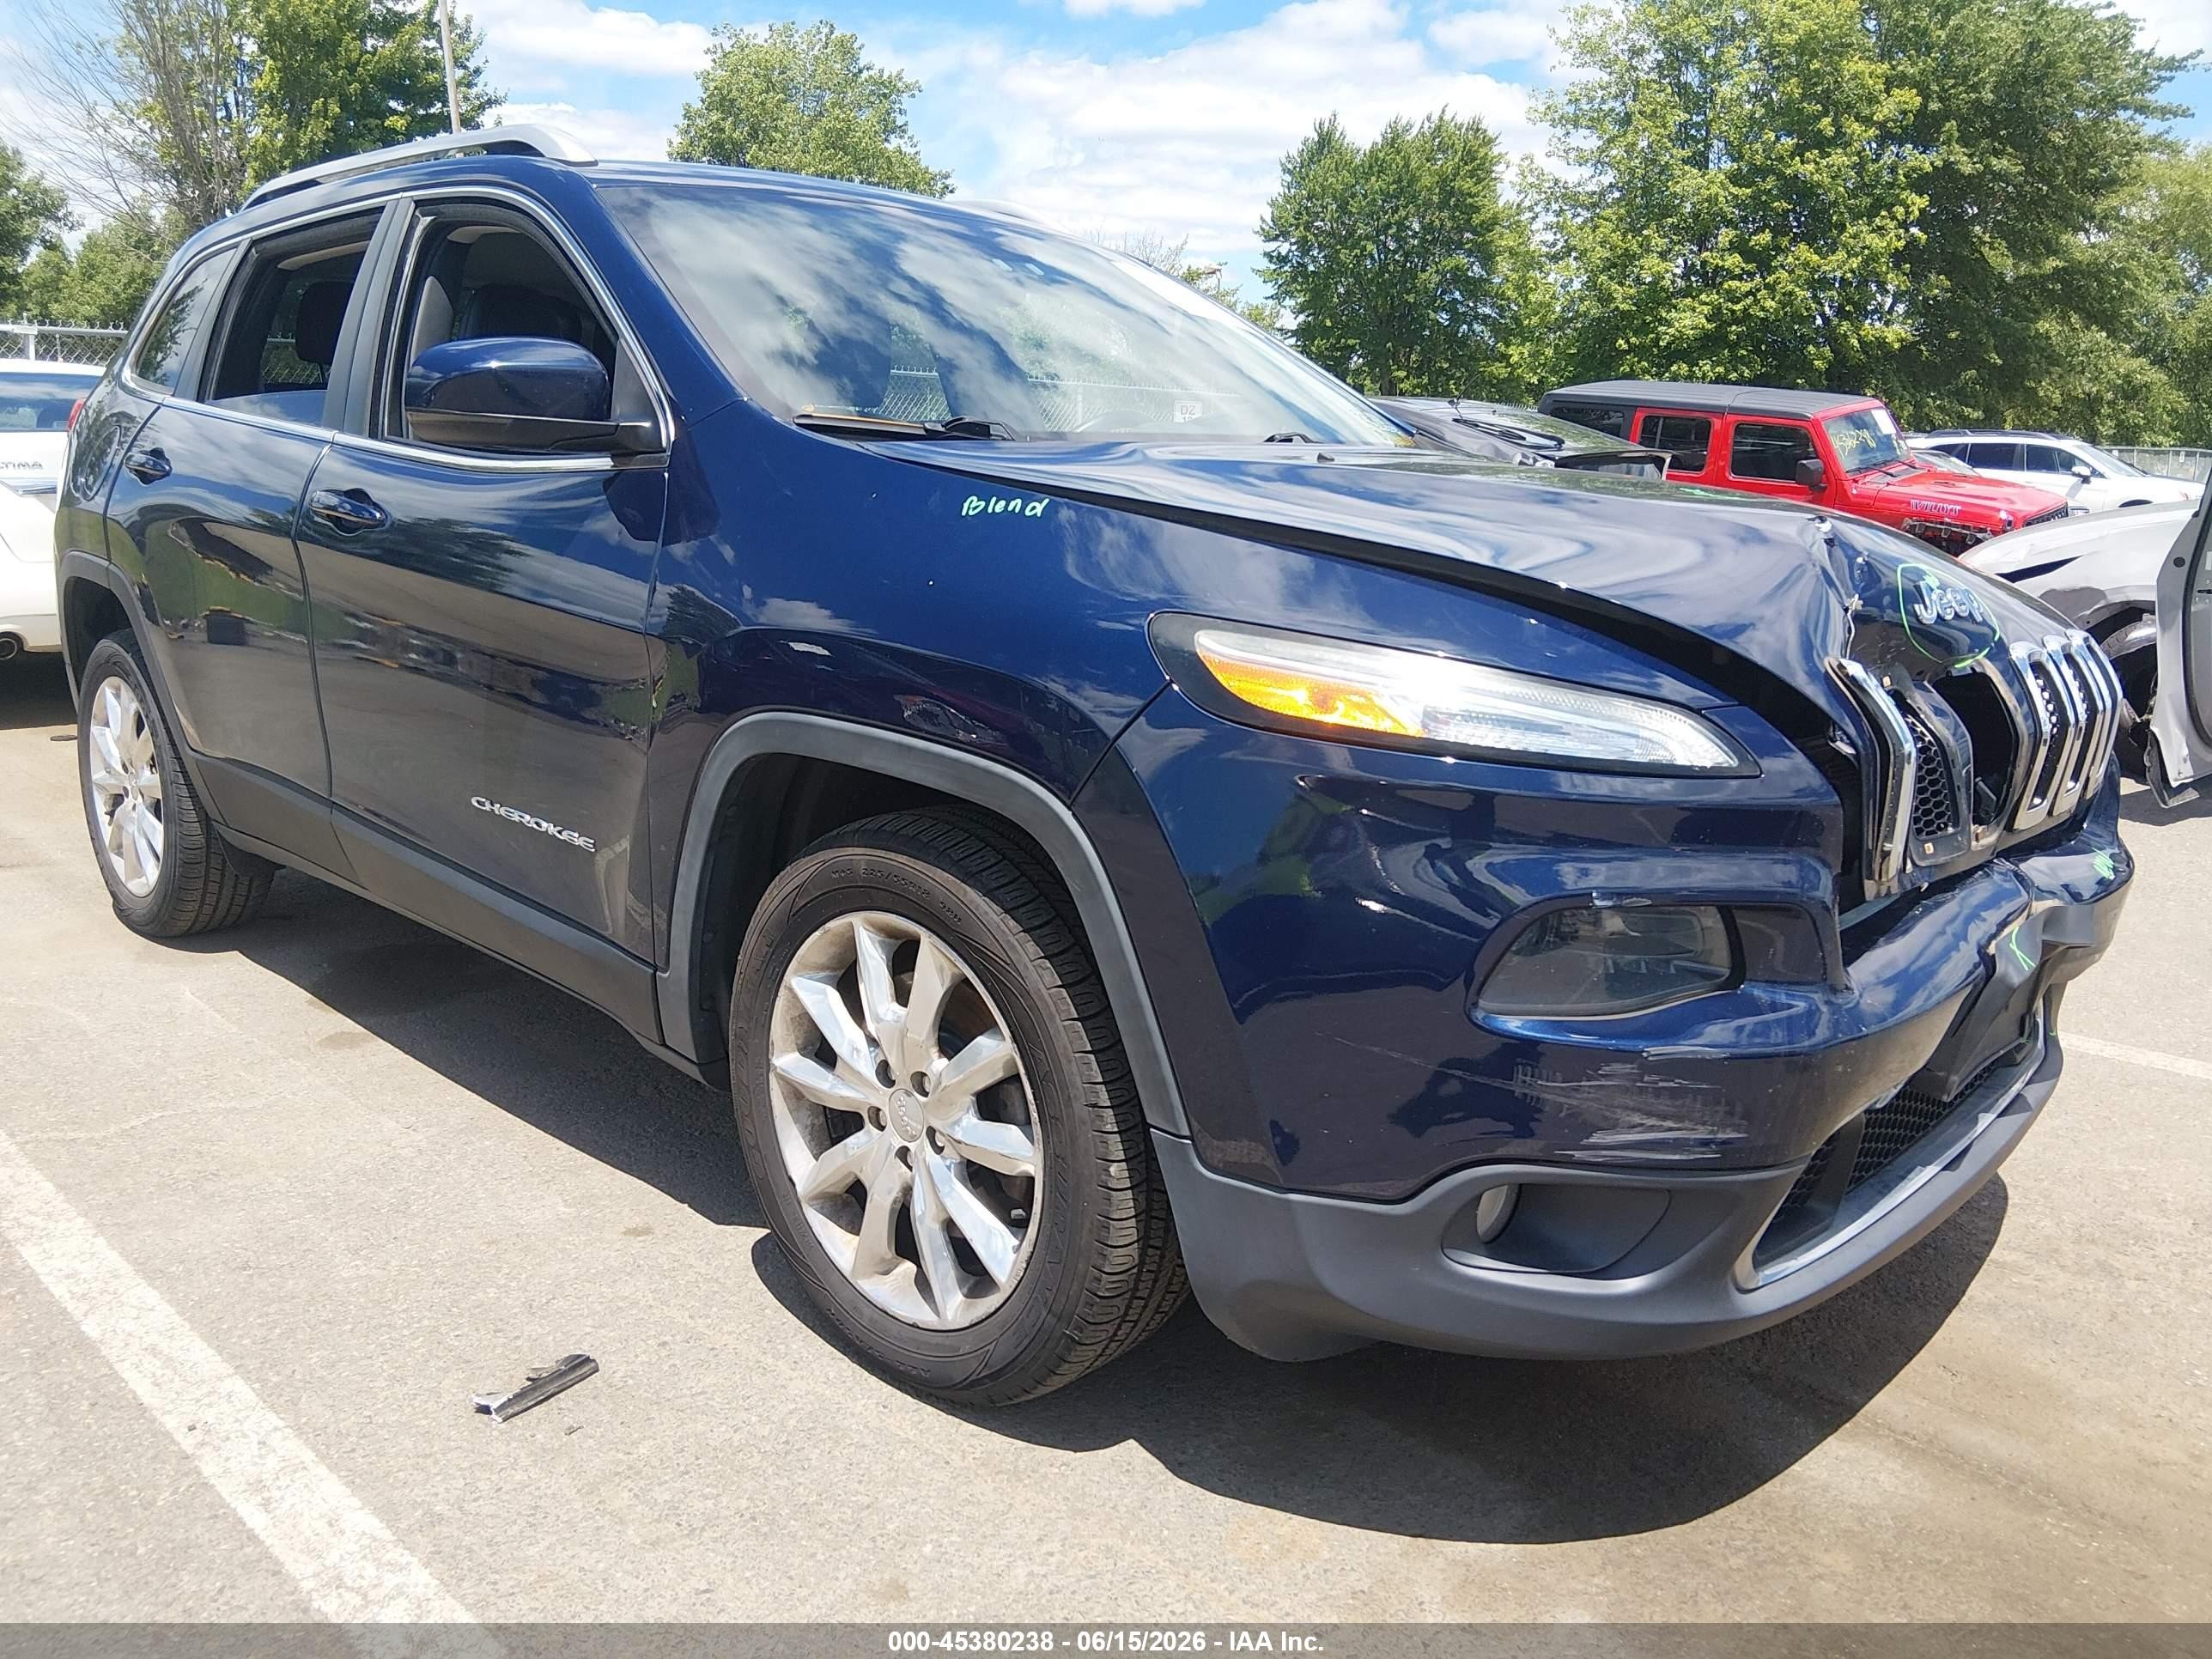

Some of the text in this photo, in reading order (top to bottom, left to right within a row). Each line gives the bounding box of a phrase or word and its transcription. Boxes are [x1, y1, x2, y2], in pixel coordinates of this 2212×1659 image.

[961, 495, 1050, 517] Blend
[1910, 500, 1962, 517] WILLYS
[1912, 580, 1984, 624] Jeep
[471, 796, 596, 853] CHEROKEE
